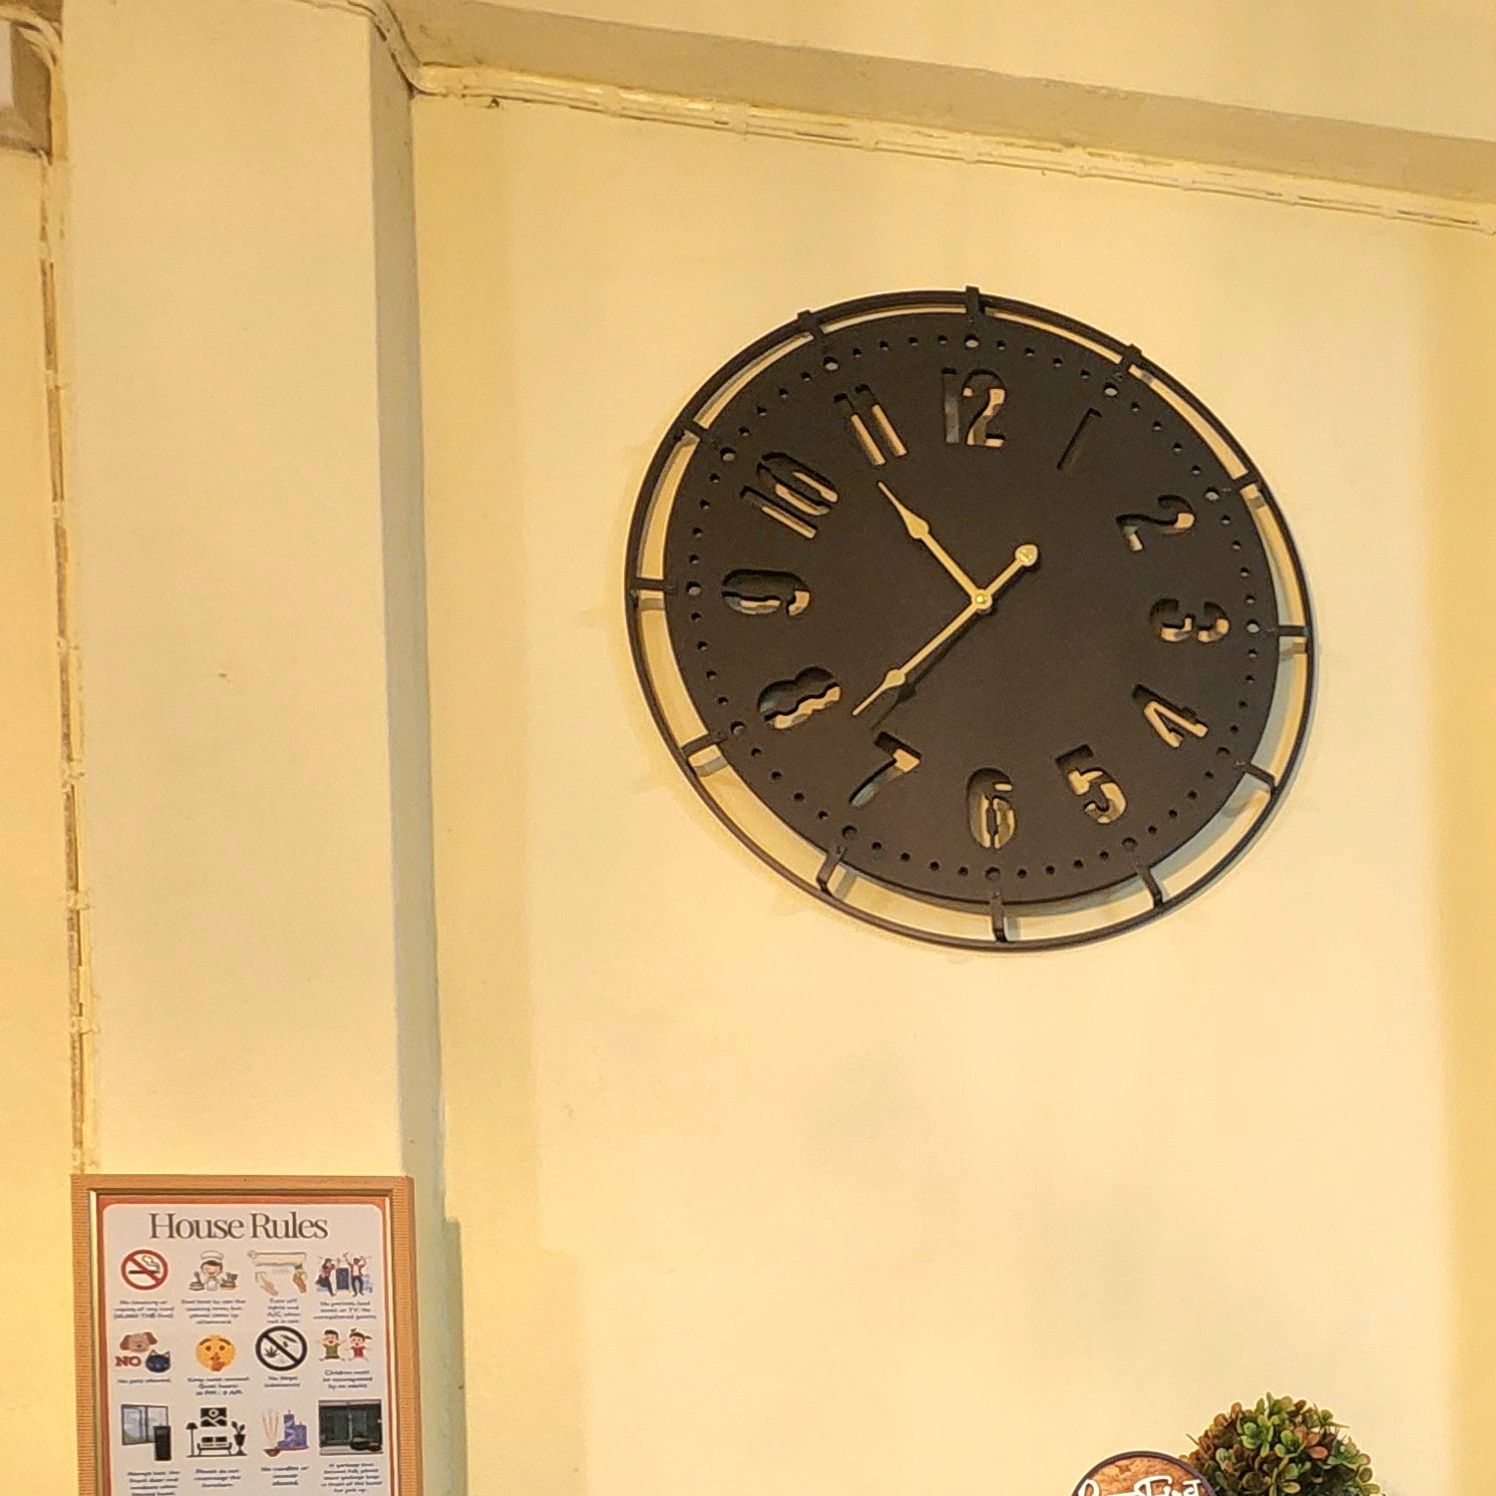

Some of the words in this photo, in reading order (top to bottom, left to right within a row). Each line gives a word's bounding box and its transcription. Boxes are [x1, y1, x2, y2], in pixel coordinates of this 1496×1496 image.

[834, 384, 907, 465] 11
[942, 368, 1006, 447] 12
[1057, 408, 1102, 471] 1
[740, 452, 838, 539] 10
[1116, 495, 1195, 552] 2
[721, 569, 811, 616] 9
[1149, 598, 1230, 643] 3
[757, 666, 841, 729] 8
[1131, 683, 1208, 747] 4
[850, 731, 921, 807] 7
[1056, 745, 1127, 824] 5
[966, 767, 1016, 848] 6
[149, 1212, 244, 1240] House
[250, 1212, 328, 1240] Rules
[115, 1356, 142, 1368] NO
